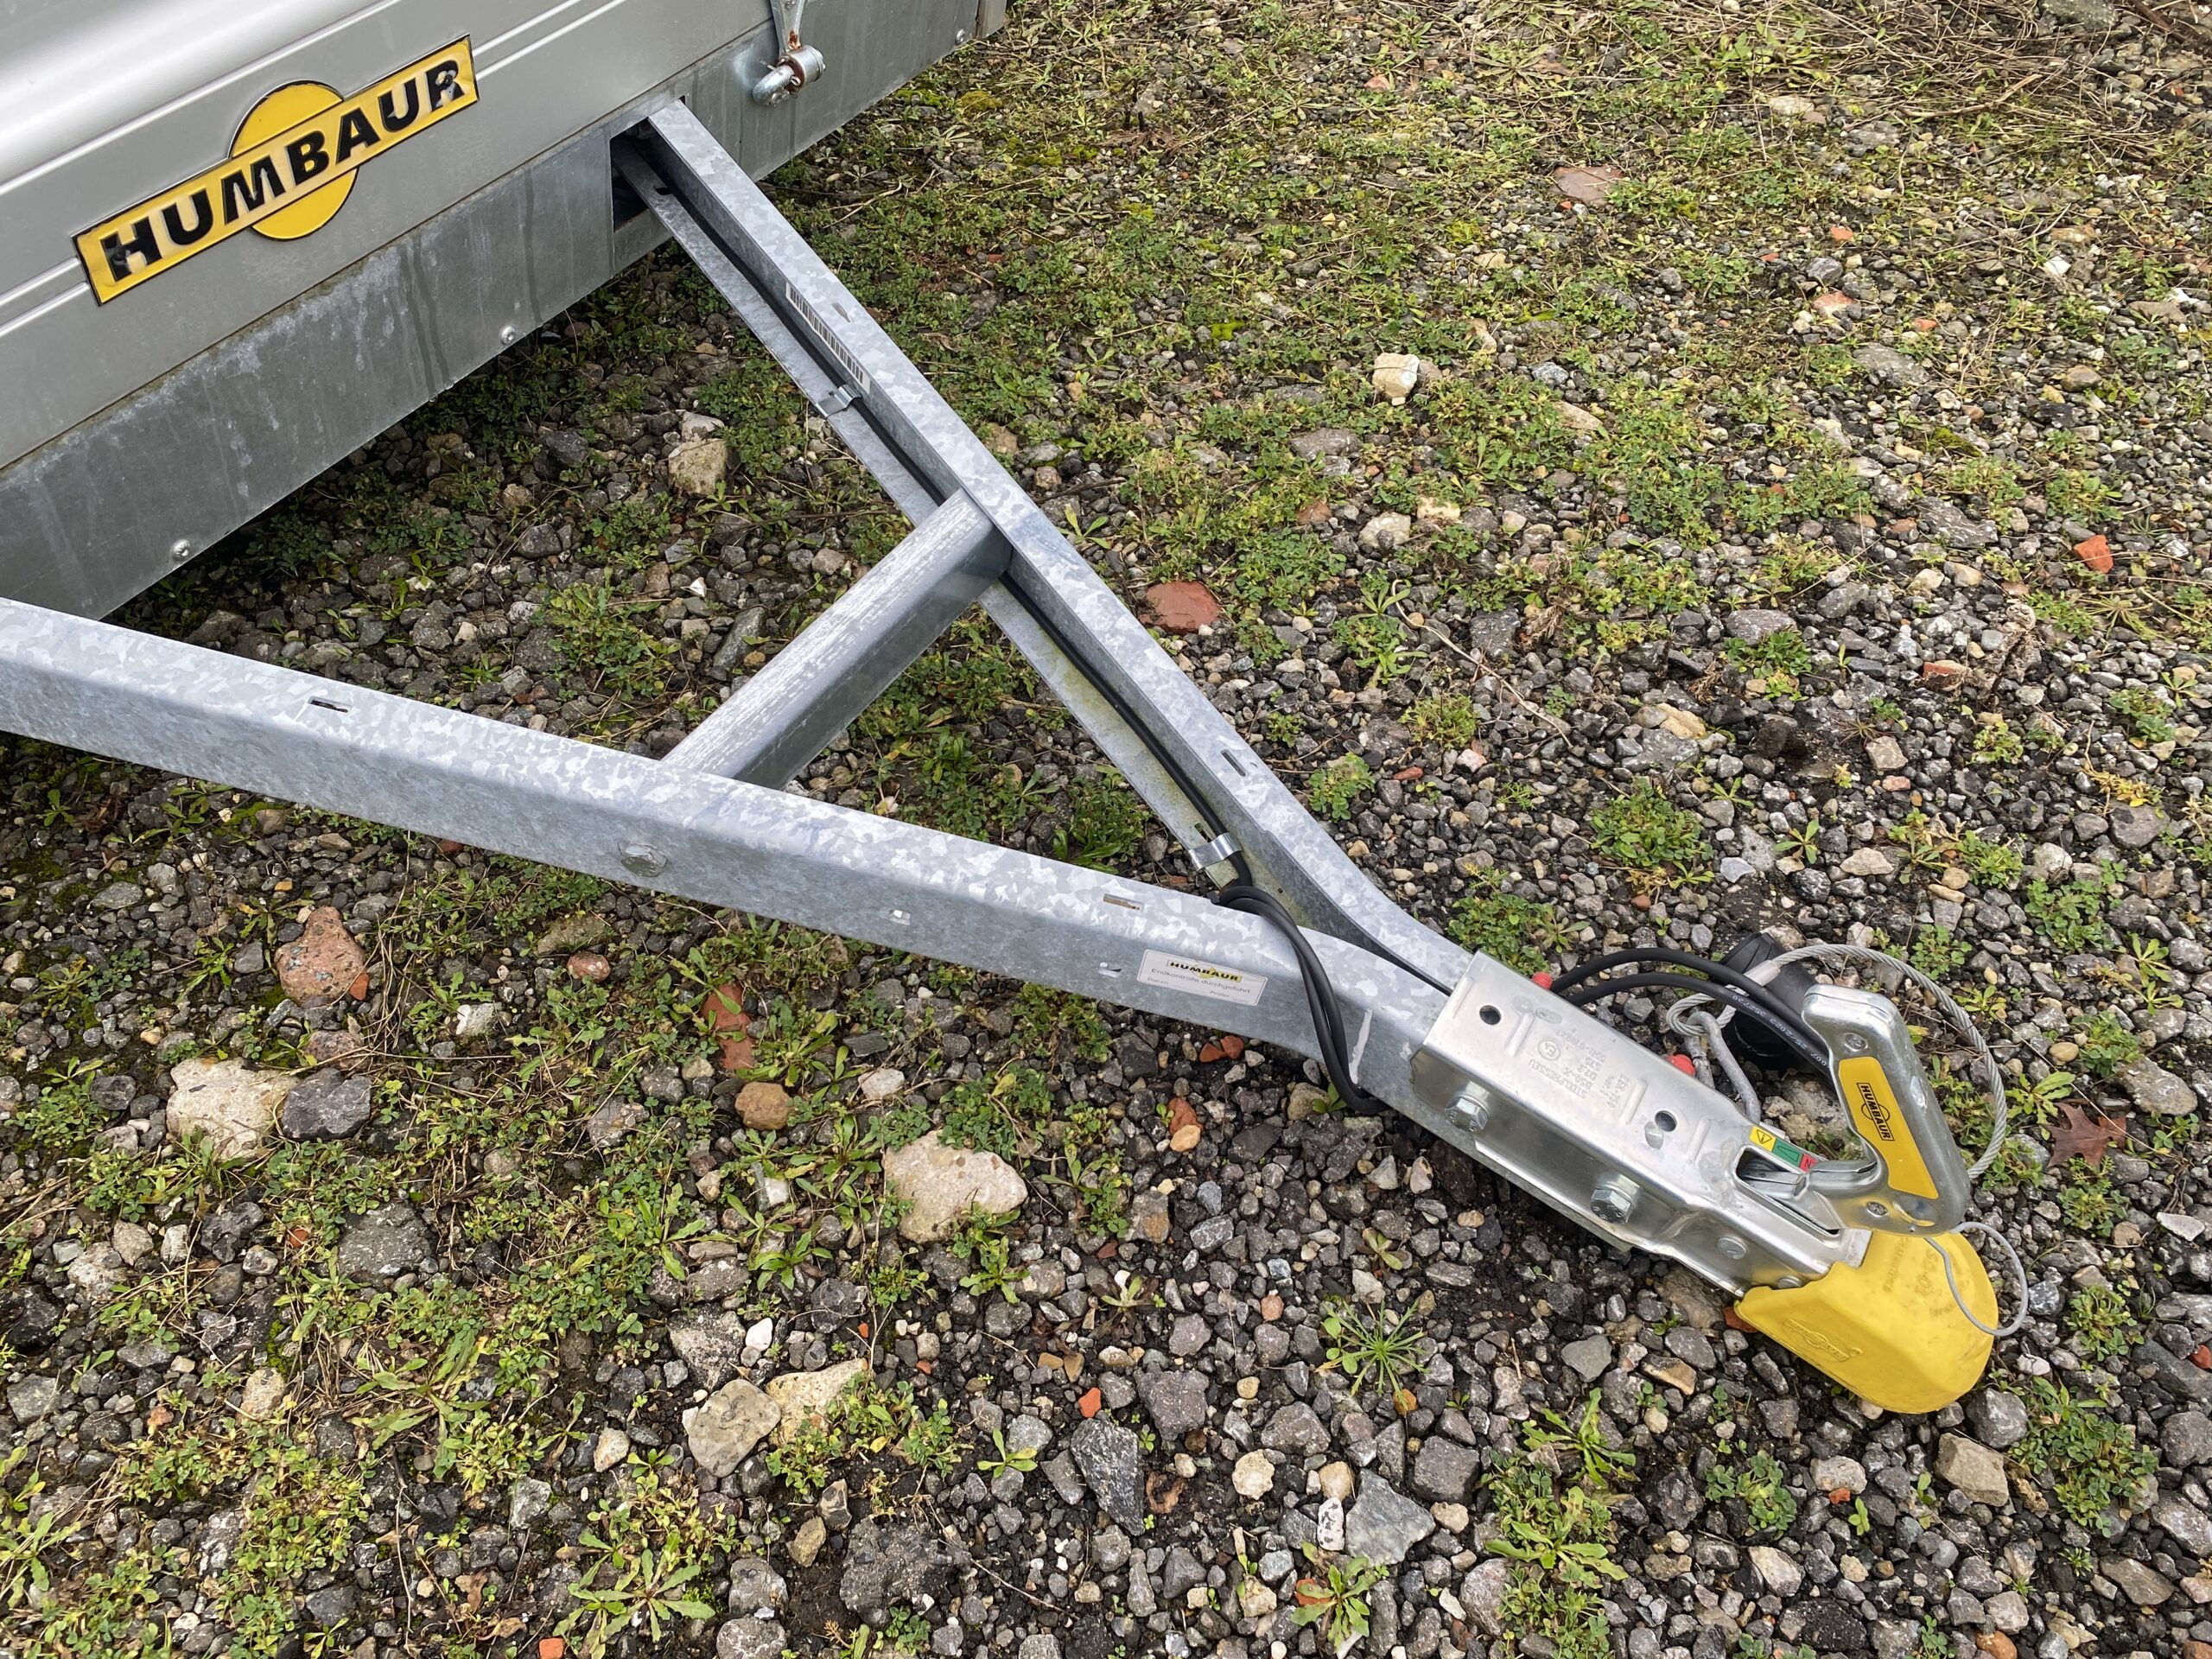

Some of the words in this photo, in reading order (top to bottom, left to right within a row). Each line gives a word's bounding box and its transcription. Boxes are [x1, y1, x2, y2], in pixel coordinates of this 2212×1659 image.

[100, 59, 466, 283] HUMBAUR
[1170, 962, 1238, 982] HUMBAUR
[1769, 1017, 1807, 1050] 25/2023
[1860, 1084, 1891, 1140] HUMBAUR
